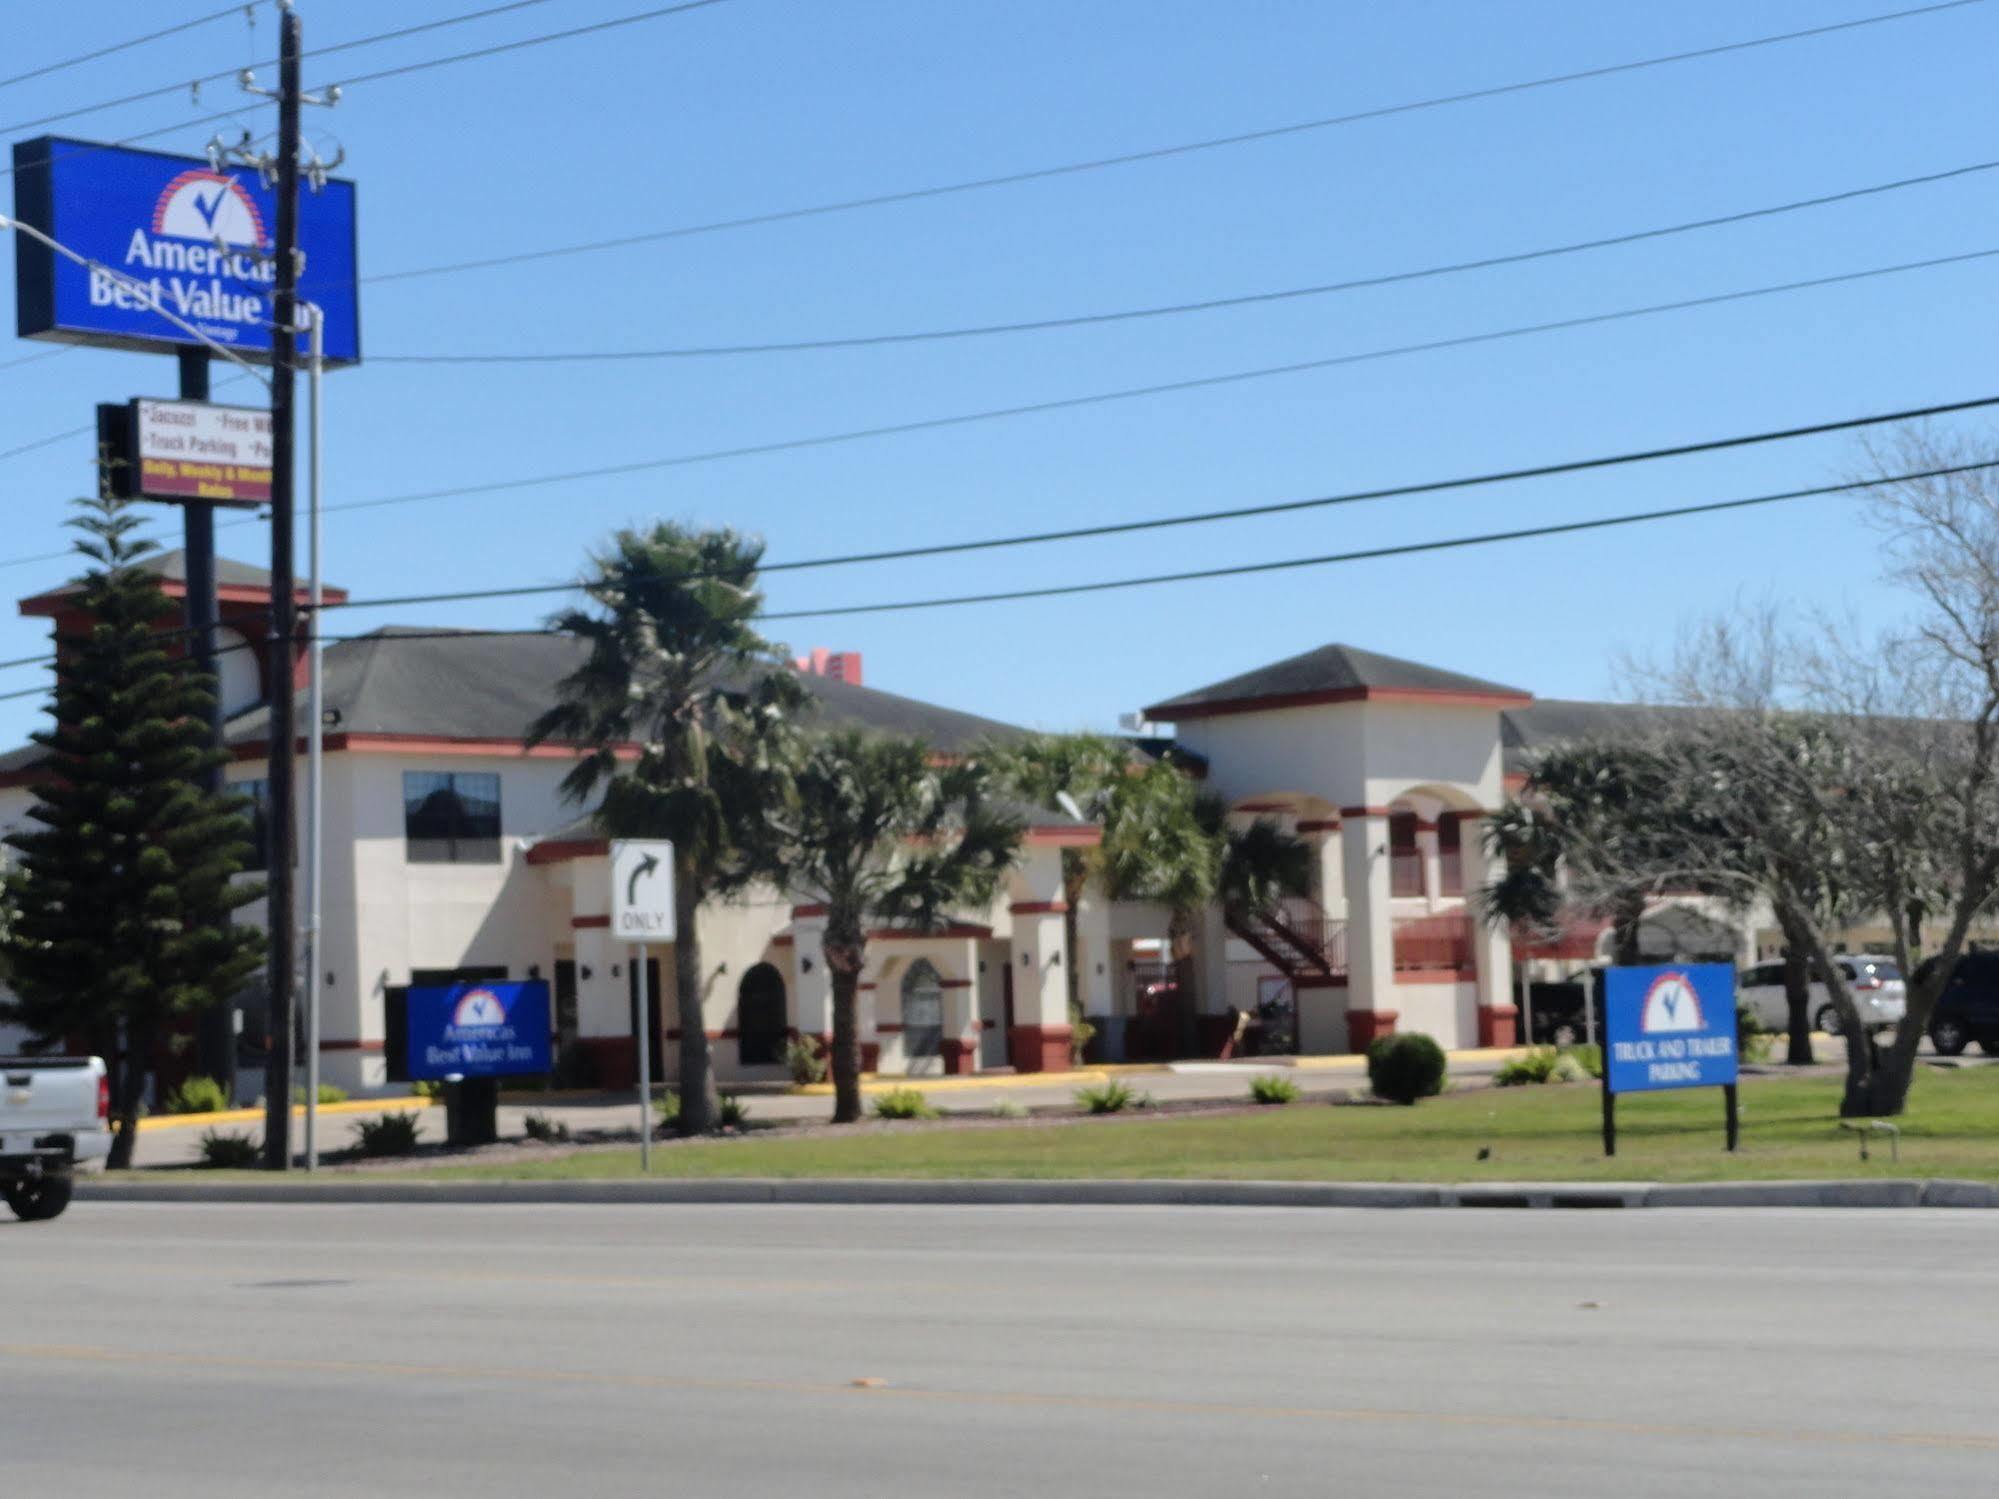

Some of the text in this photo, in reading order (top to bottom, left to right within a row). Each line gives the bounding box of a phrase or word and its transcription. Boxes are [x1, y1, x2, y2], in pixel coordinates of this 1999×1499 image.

[90, 270, 161, 311] Best
[170, 276, 262, 323] Value
[151, 432, 184, 450] Truck
[190, 436, 237, 457] Parking
[623, 911, 664, 930] ONLY
[426, 1043, 533, 1064] Best Value Inn
[1614, 1037, 1732, 1061] TRUCK AND TRAILER
[1649, 1061, 1701, 1082] PARKING
